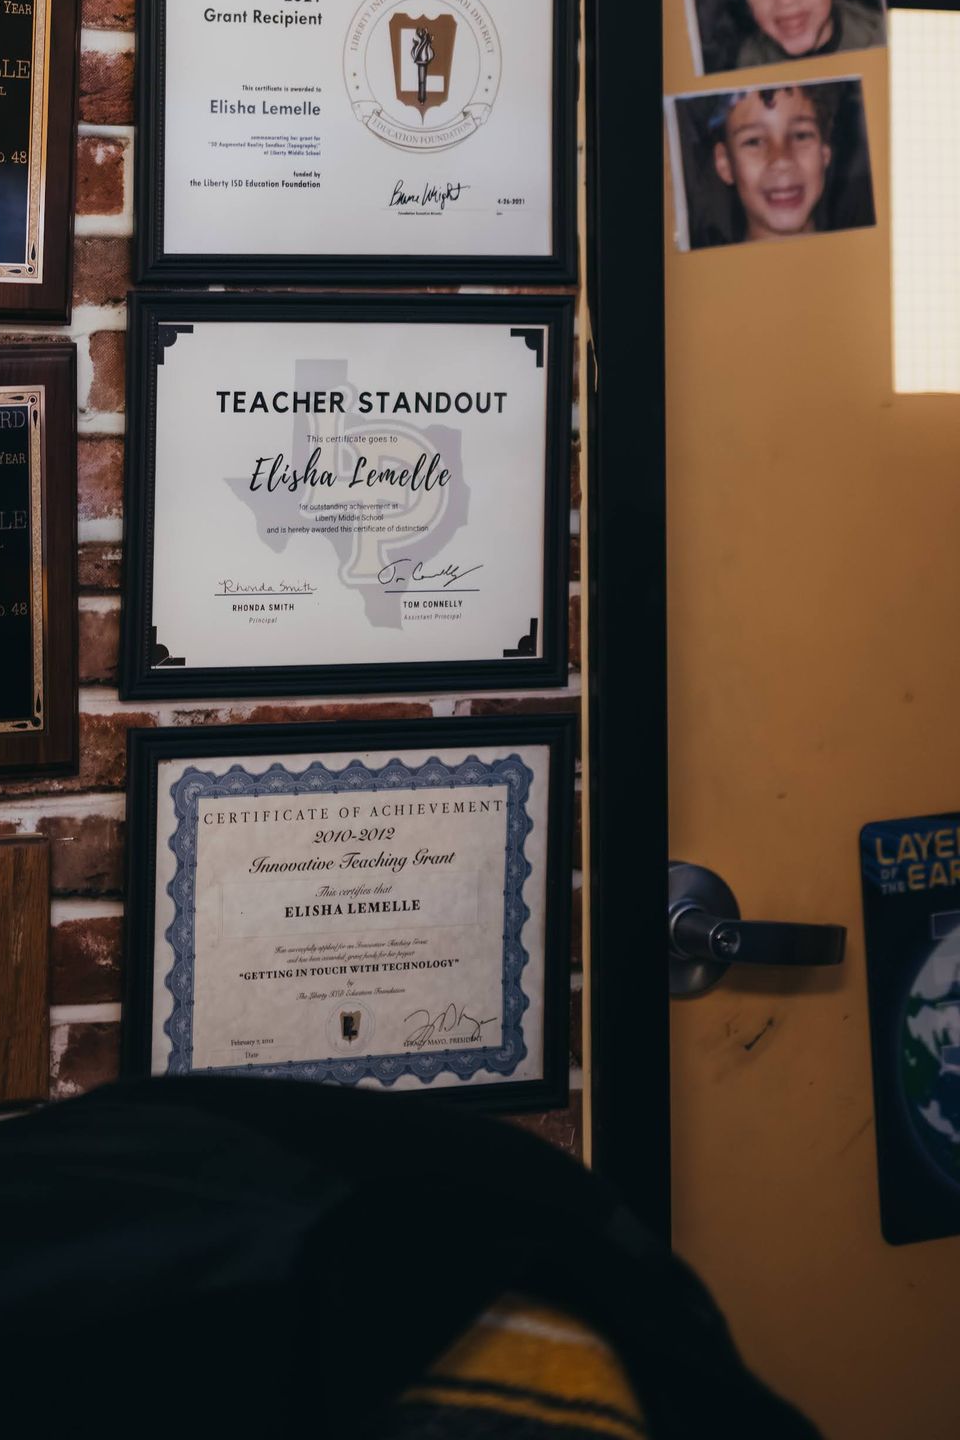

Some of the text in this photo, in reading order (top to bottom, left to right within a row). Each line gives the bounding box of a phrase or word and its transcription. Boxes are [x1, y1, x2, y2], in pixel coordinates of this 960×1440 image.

[204, 8, 322, 28] Grant Recipient
[210, 99, 321, 116] Elisha Lemelle
[216, 391, 507, 413] TEACHER STANDOUT
[306, 434, 398, 445] This certificate goes to
[249, 447, 451, 492] Elisha Lemelle
[232, 603, 294, 612] RHONDA SMITH
[423, 600, 462, 608] CONNELLY
[204, 800, 503, 825] CERTIFICATE OF ACHIEVEMENT
[875, 826, 960, 866] LAYE
[249, 849, 455, 873] Innovative Teaching Grant
[285, 899, 420, 918] ELISHA LEMELLE
[296, 969, 307, 977] IN
[310, 966, 347, 976] TOUCH
[350, 964, 379, 973] WITH
